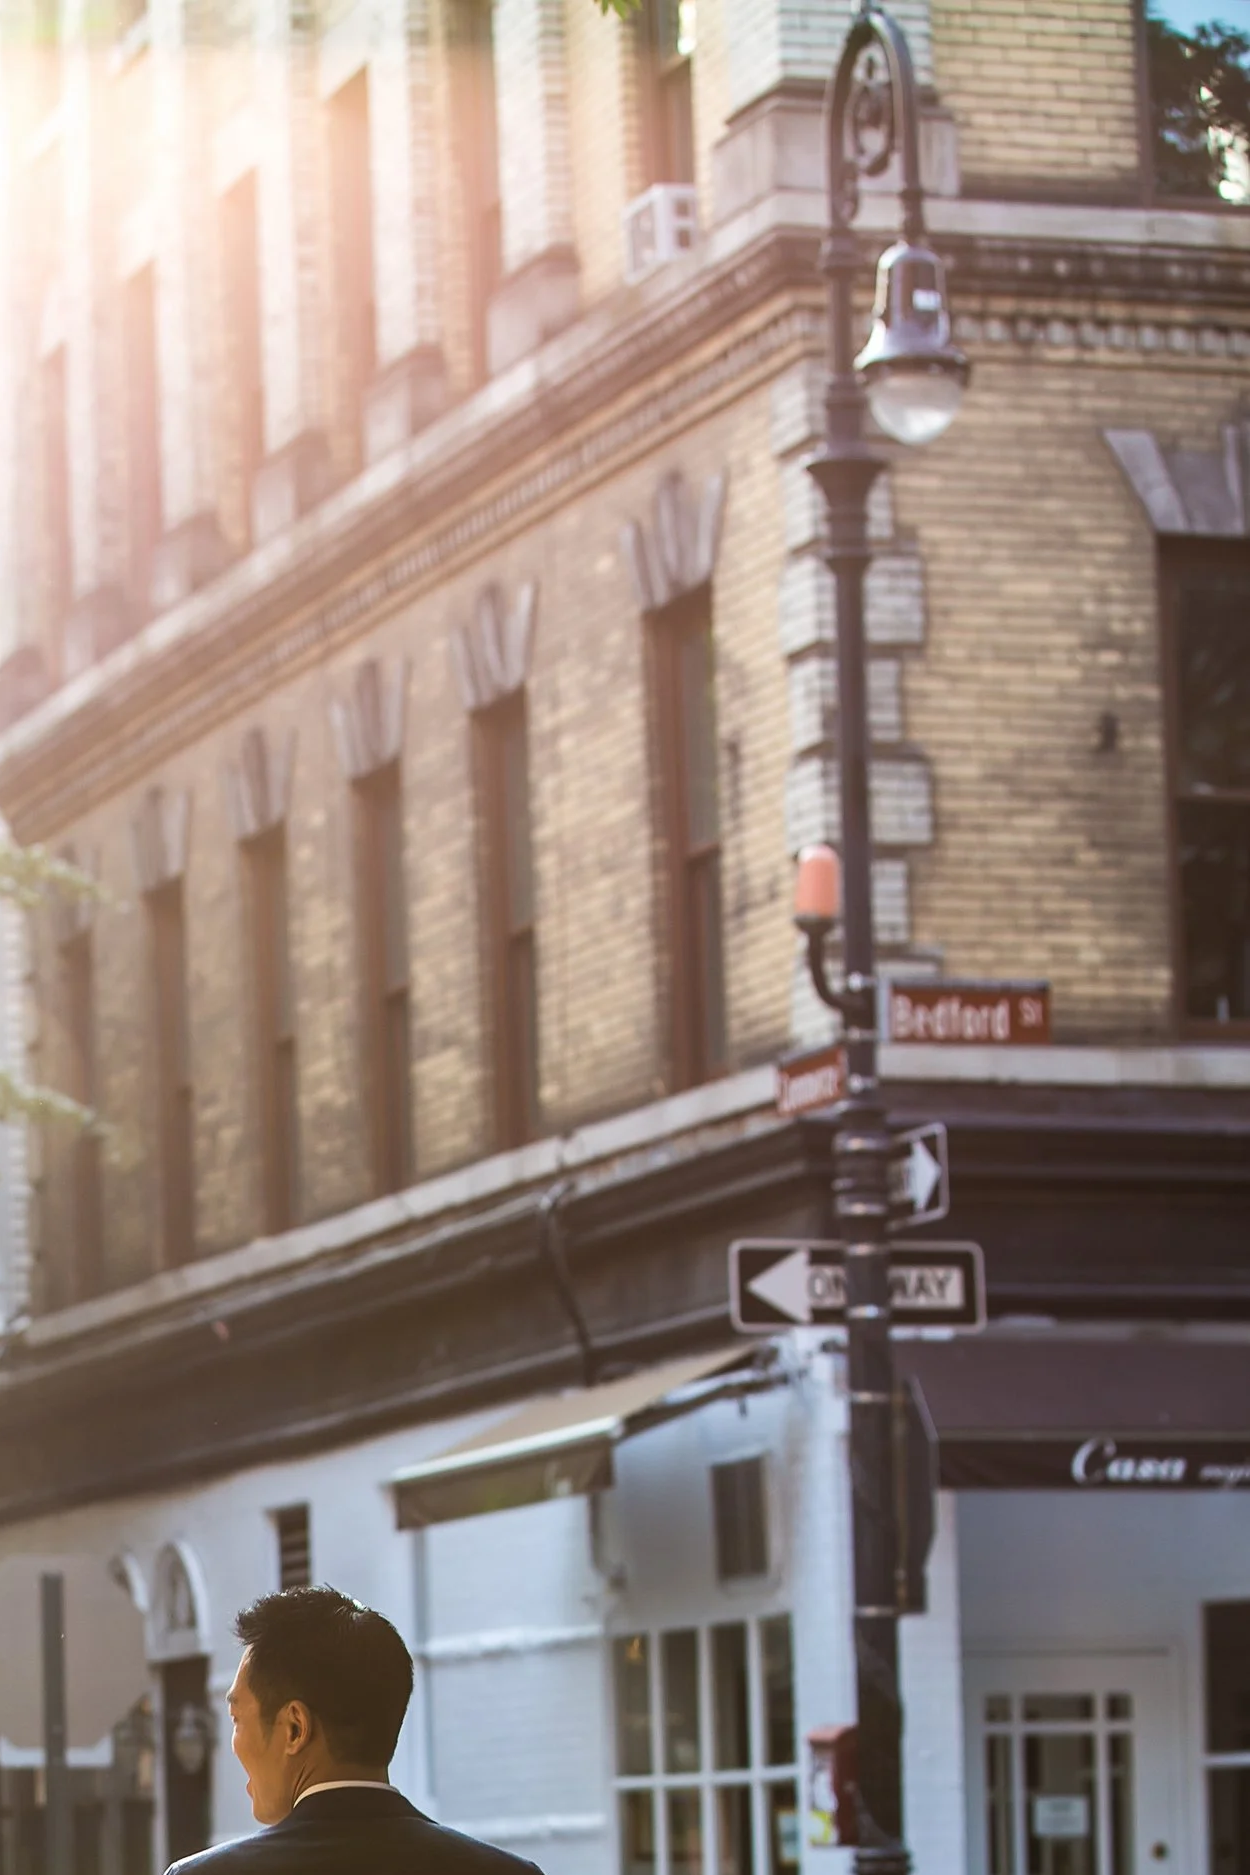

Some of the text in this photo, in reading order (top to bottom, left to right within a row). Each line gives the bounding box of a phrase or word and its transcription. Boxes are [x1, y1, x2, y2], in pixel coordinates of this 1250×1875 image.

[892, 994, 1044, 1040] Bedford St
[807, 1269, 847, 1300] ON
[1071, 1436, 1187, 1485] Casa
